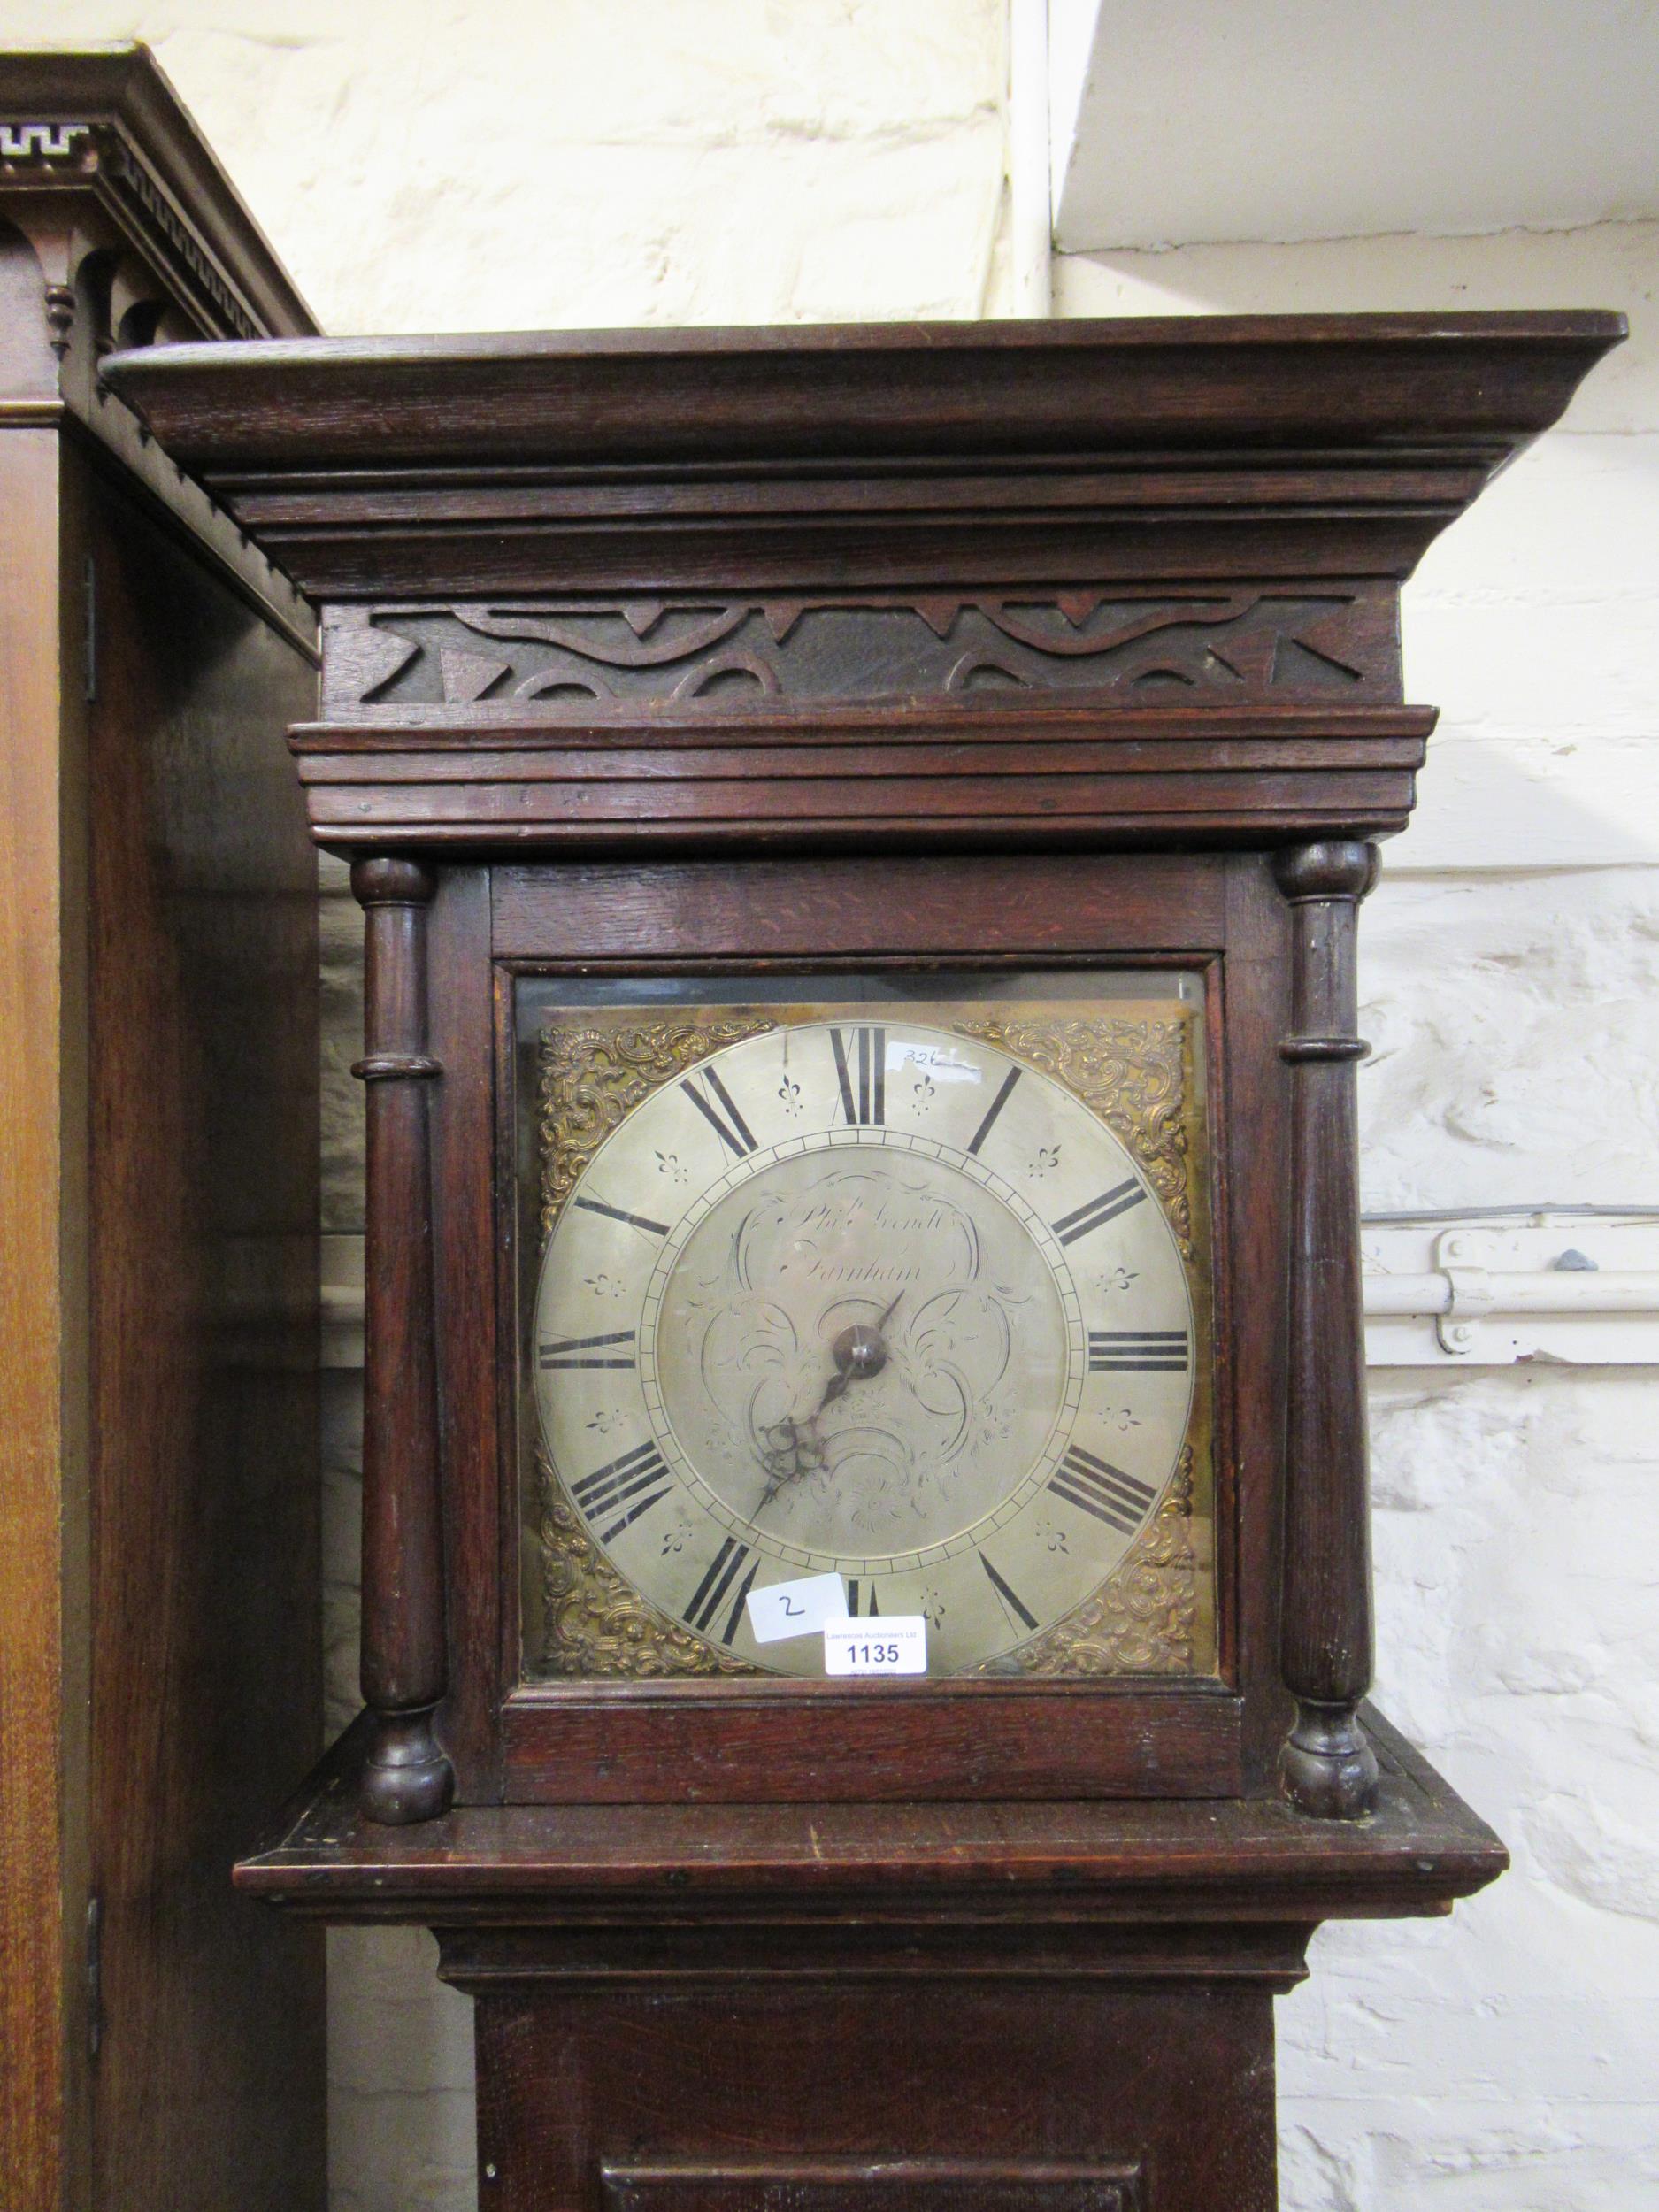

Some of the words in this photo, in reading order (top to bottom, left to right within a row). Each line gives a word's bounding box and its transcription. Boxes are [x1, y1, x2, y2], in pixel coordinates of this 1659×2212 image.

[828, 1027, 887, 1125] XII
[676, 1064, 758, 1168] XI
[539, 1329, 636, 1370] IX
[1088, 1331, 1188, 1371] III
[778, 1595, 806, 1617] 2
[847, 1644, 900, 1663] 1135
